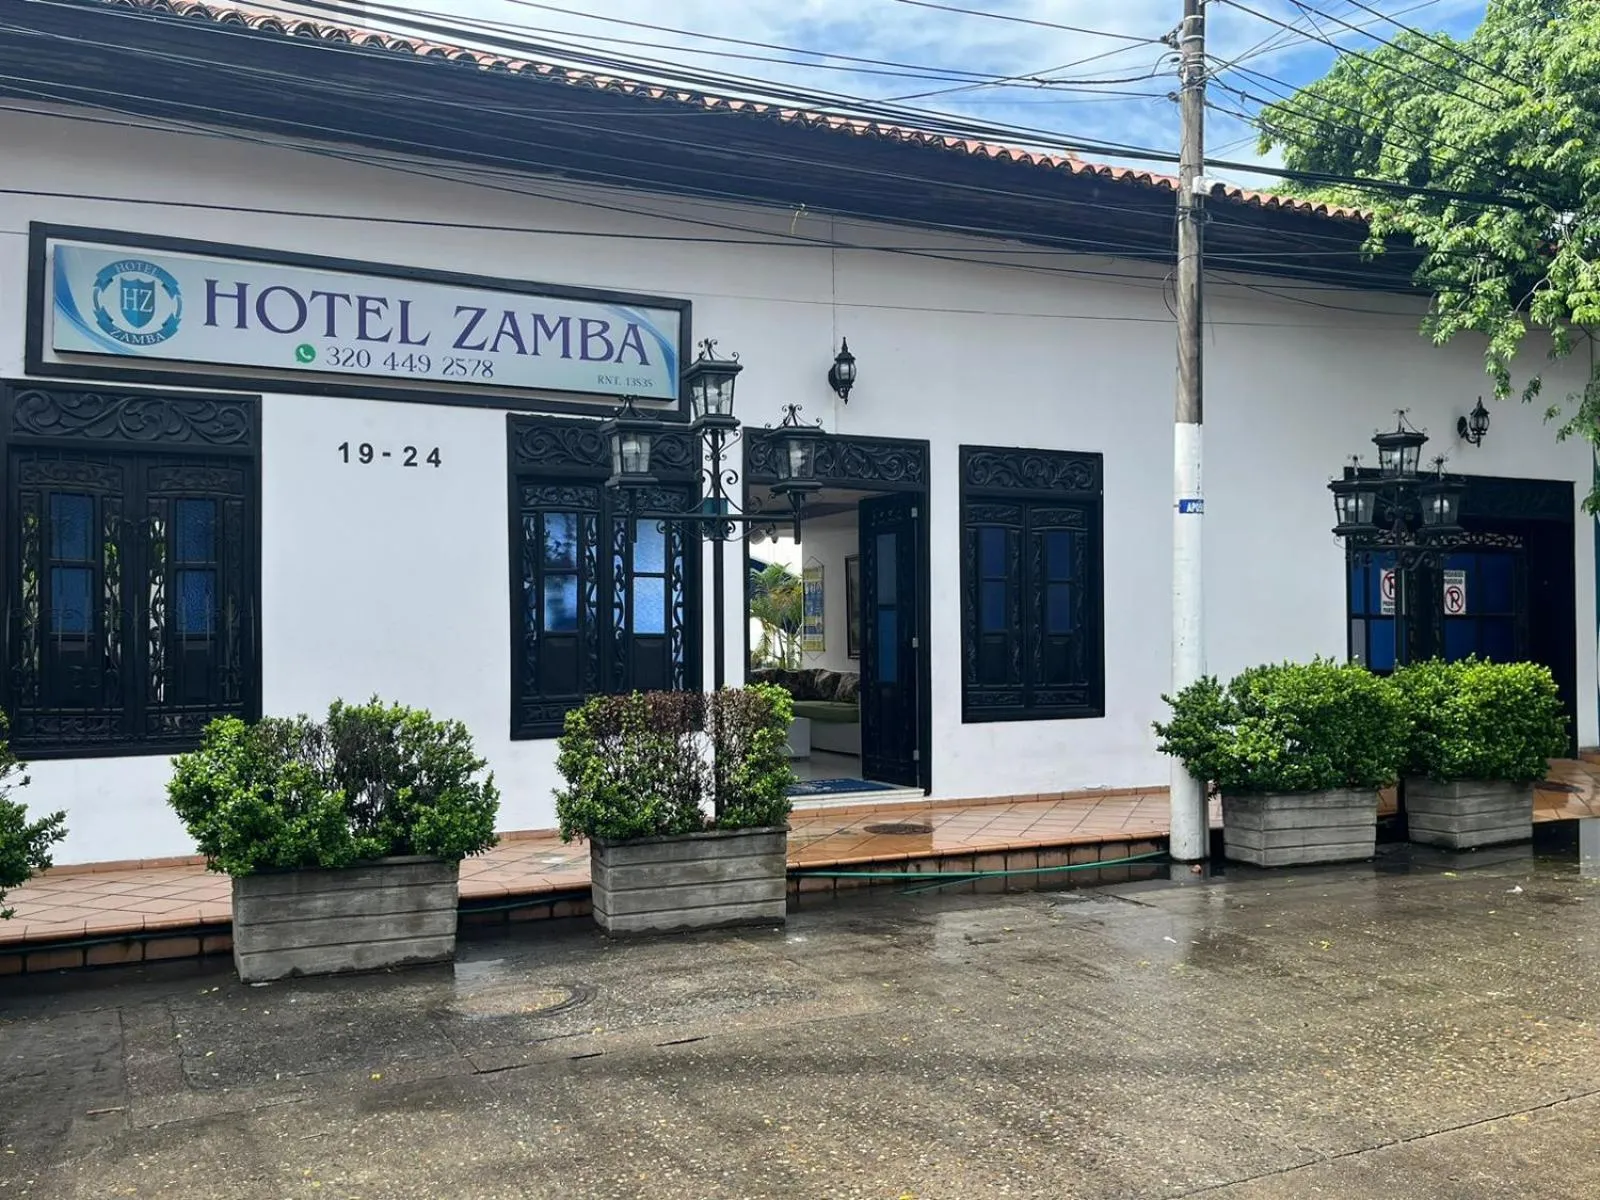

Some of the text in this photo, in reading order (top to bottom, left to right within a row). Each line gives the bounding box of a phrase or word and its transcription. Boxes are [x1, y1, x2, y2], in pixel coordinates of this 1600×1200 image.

[114, 261, 159, 276] HOTEL
[122, 287, 153, 313] HZ
[203, 279, 651, 366] HOTEL ZAMBA
[111, 329, 165, 345] ZAMBA
[326, 346, 494, 378] 320 449 2578
